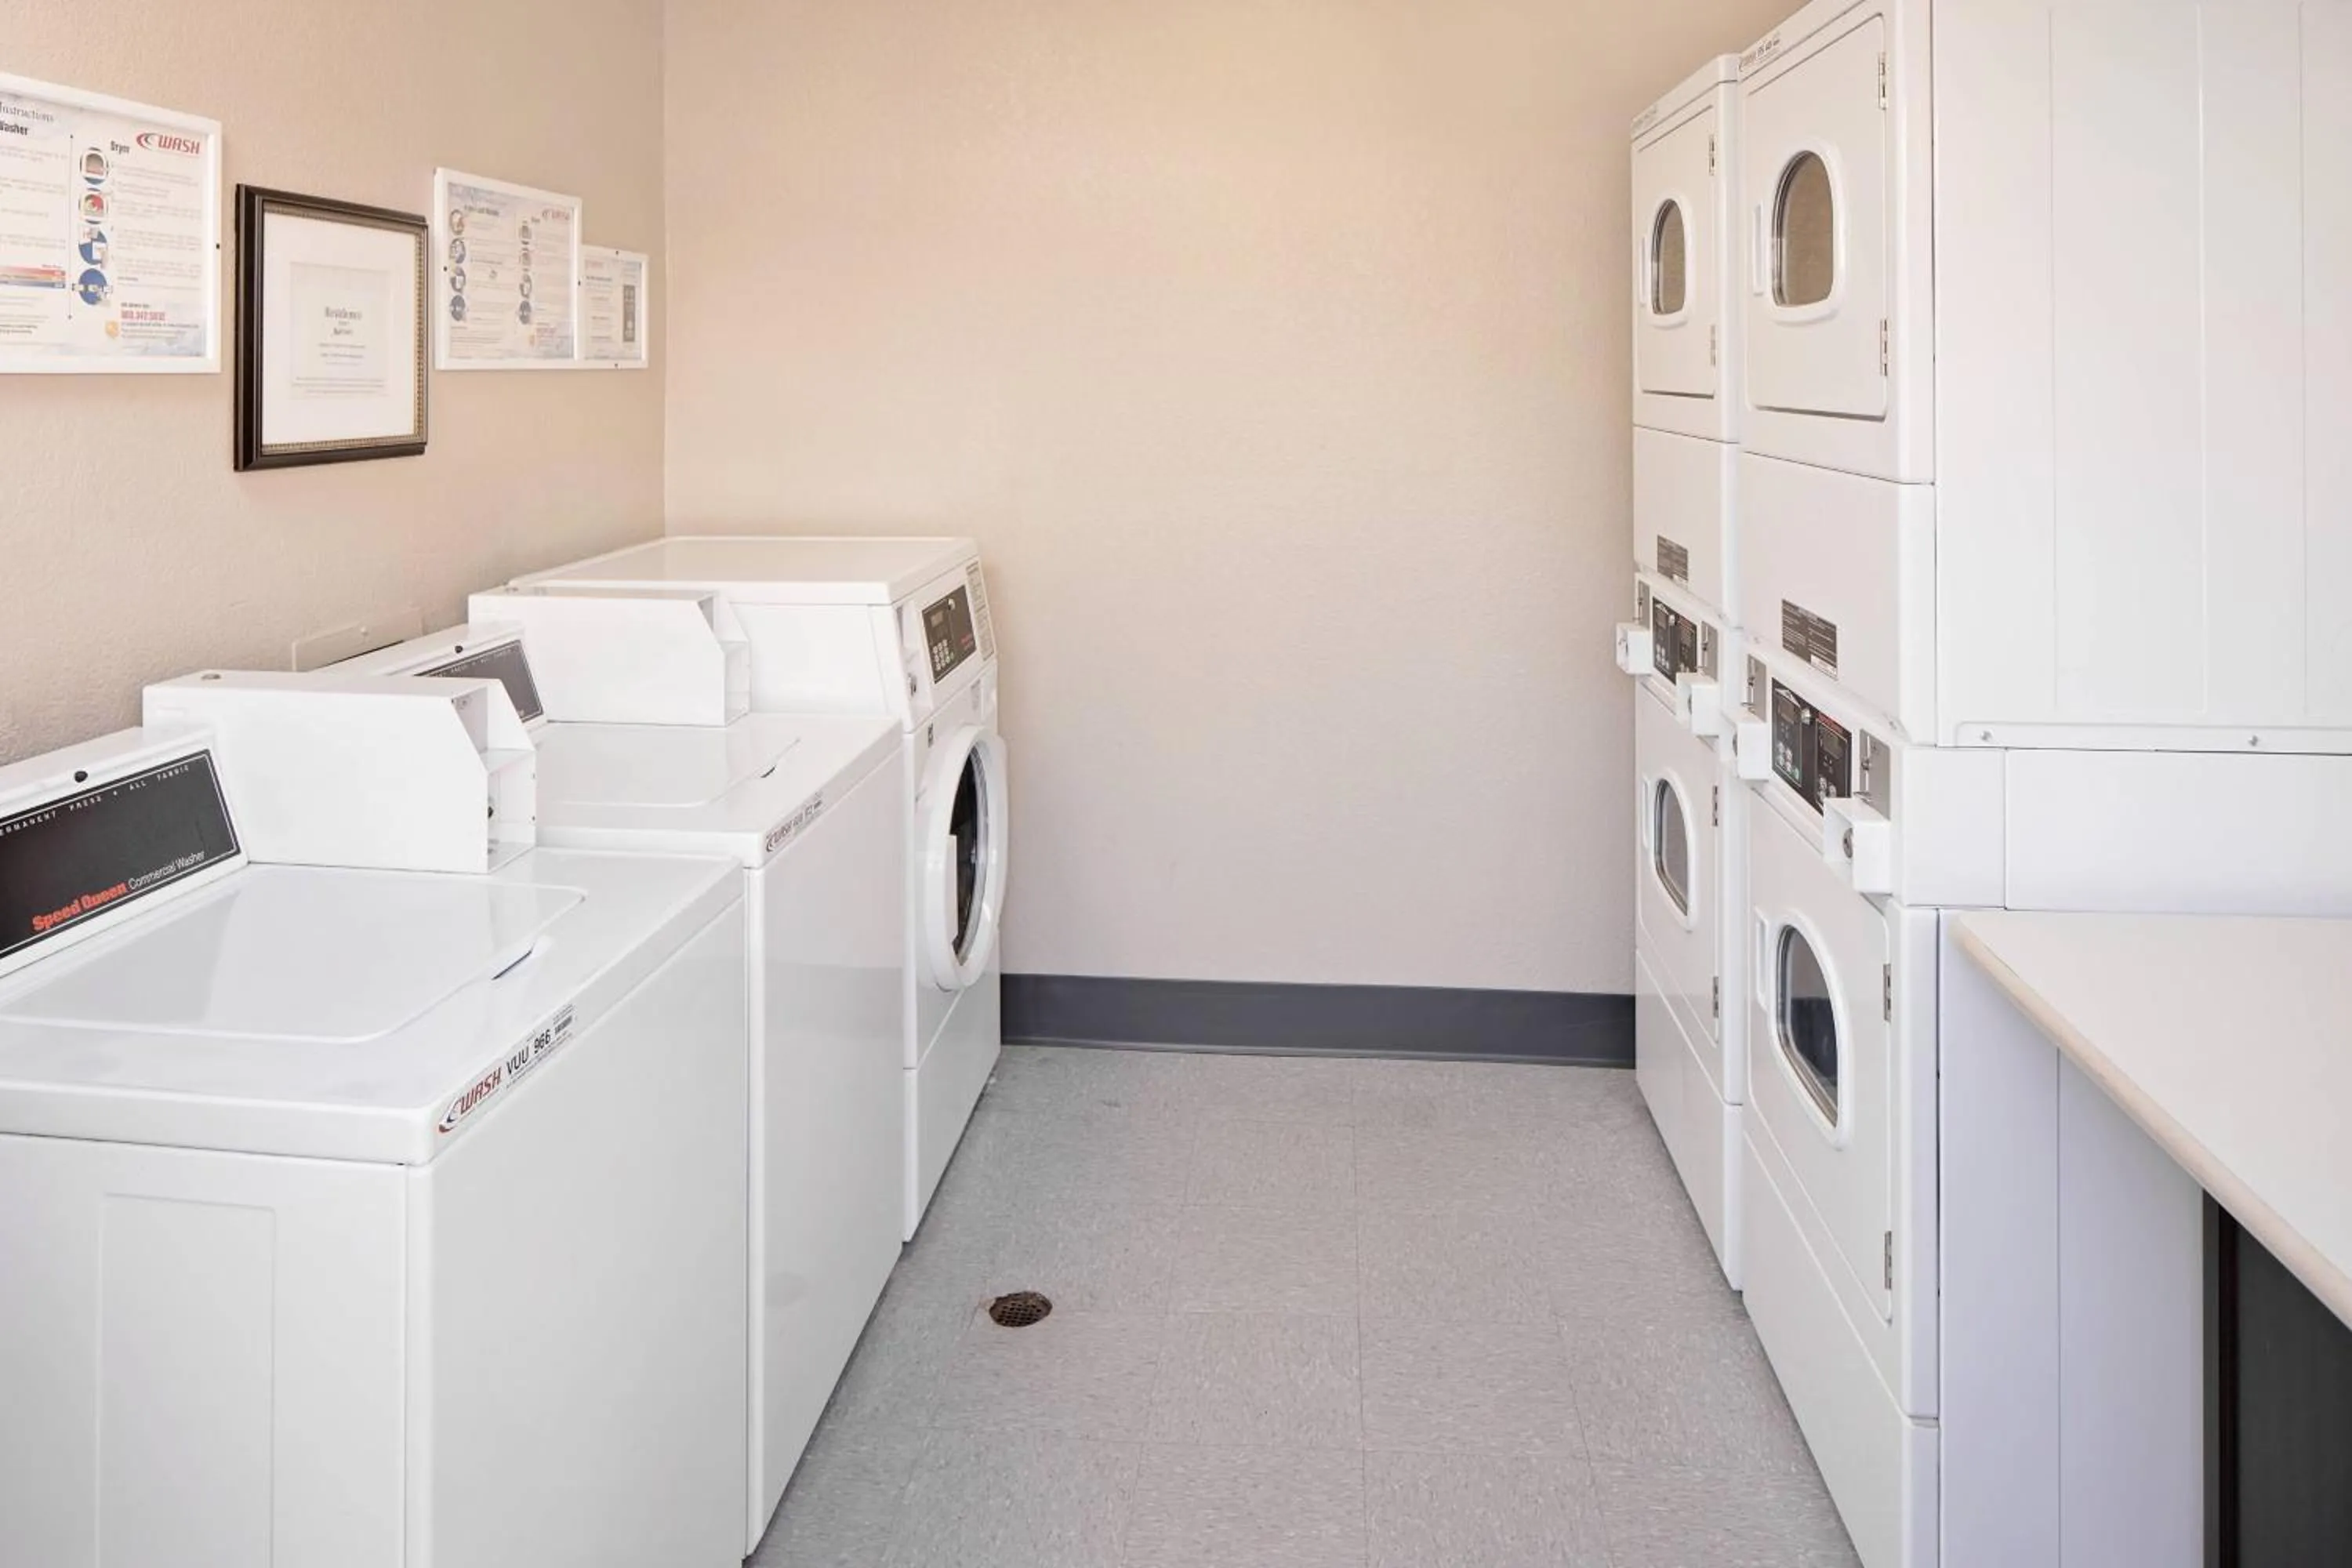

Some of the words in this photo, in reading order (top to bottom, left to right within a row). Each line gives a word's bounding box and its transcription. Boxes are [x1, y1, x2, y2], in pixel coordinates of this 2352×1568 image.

[32, 898, 81, 931] Speed
[81, 882, 127, 909] Queen
[128, 860, 176, 890] Commercial
[175, 850, 205, 870] Washer
[459, 1065, 503, 1116] WASH
[534, 1028, 551, 1054] 966
